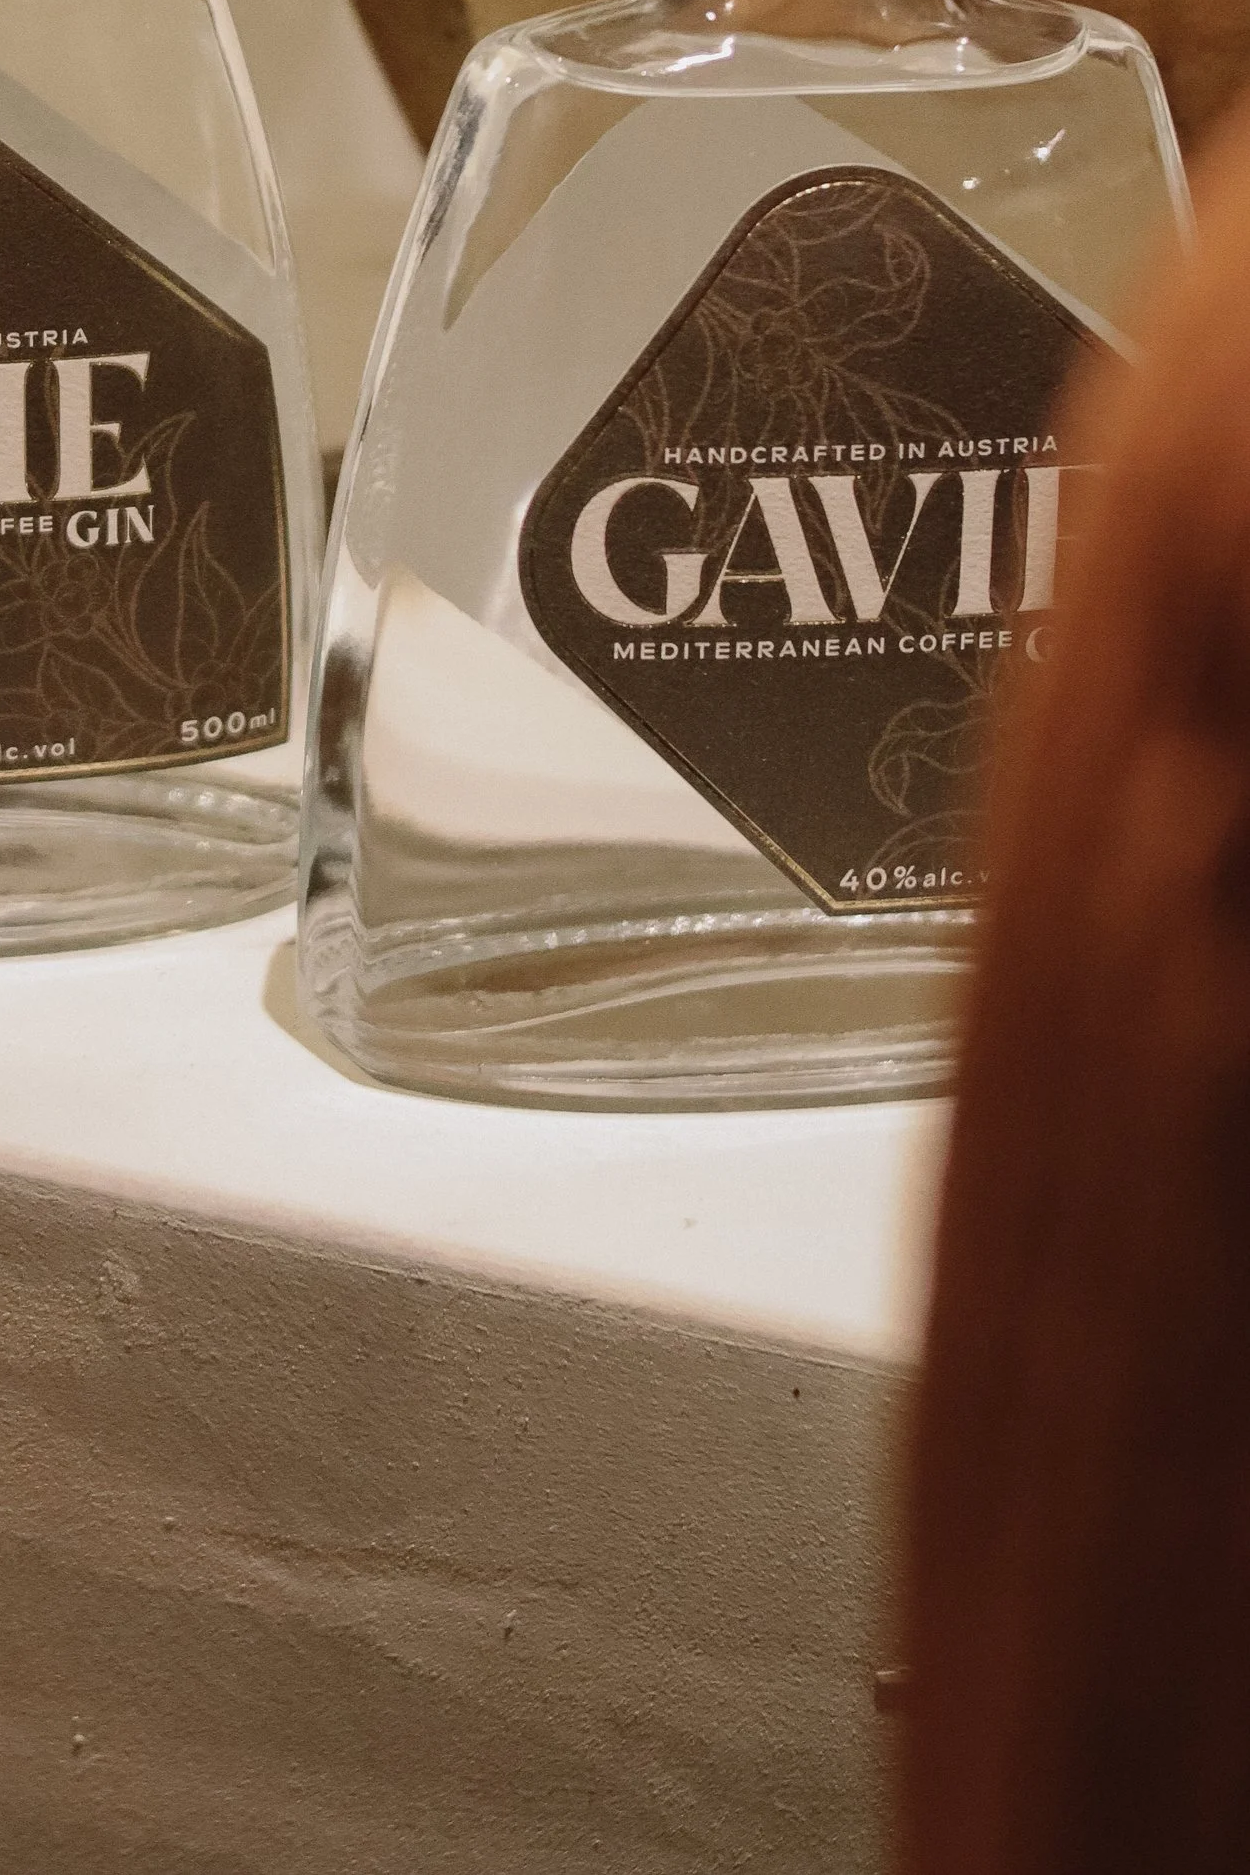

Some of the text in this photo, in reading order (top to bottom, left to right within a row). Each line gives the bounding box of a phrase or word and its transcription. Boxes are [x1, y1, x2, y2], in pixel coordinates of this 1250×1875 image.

[663, 435, 1058, 465] HANDCRAFTED IN AUSTRIA
[66, 504, 155, 549] GIN
[612, 636, 886, 661] MEDITERRANEAN
[897, 630, 1013, 655] COFFEE
